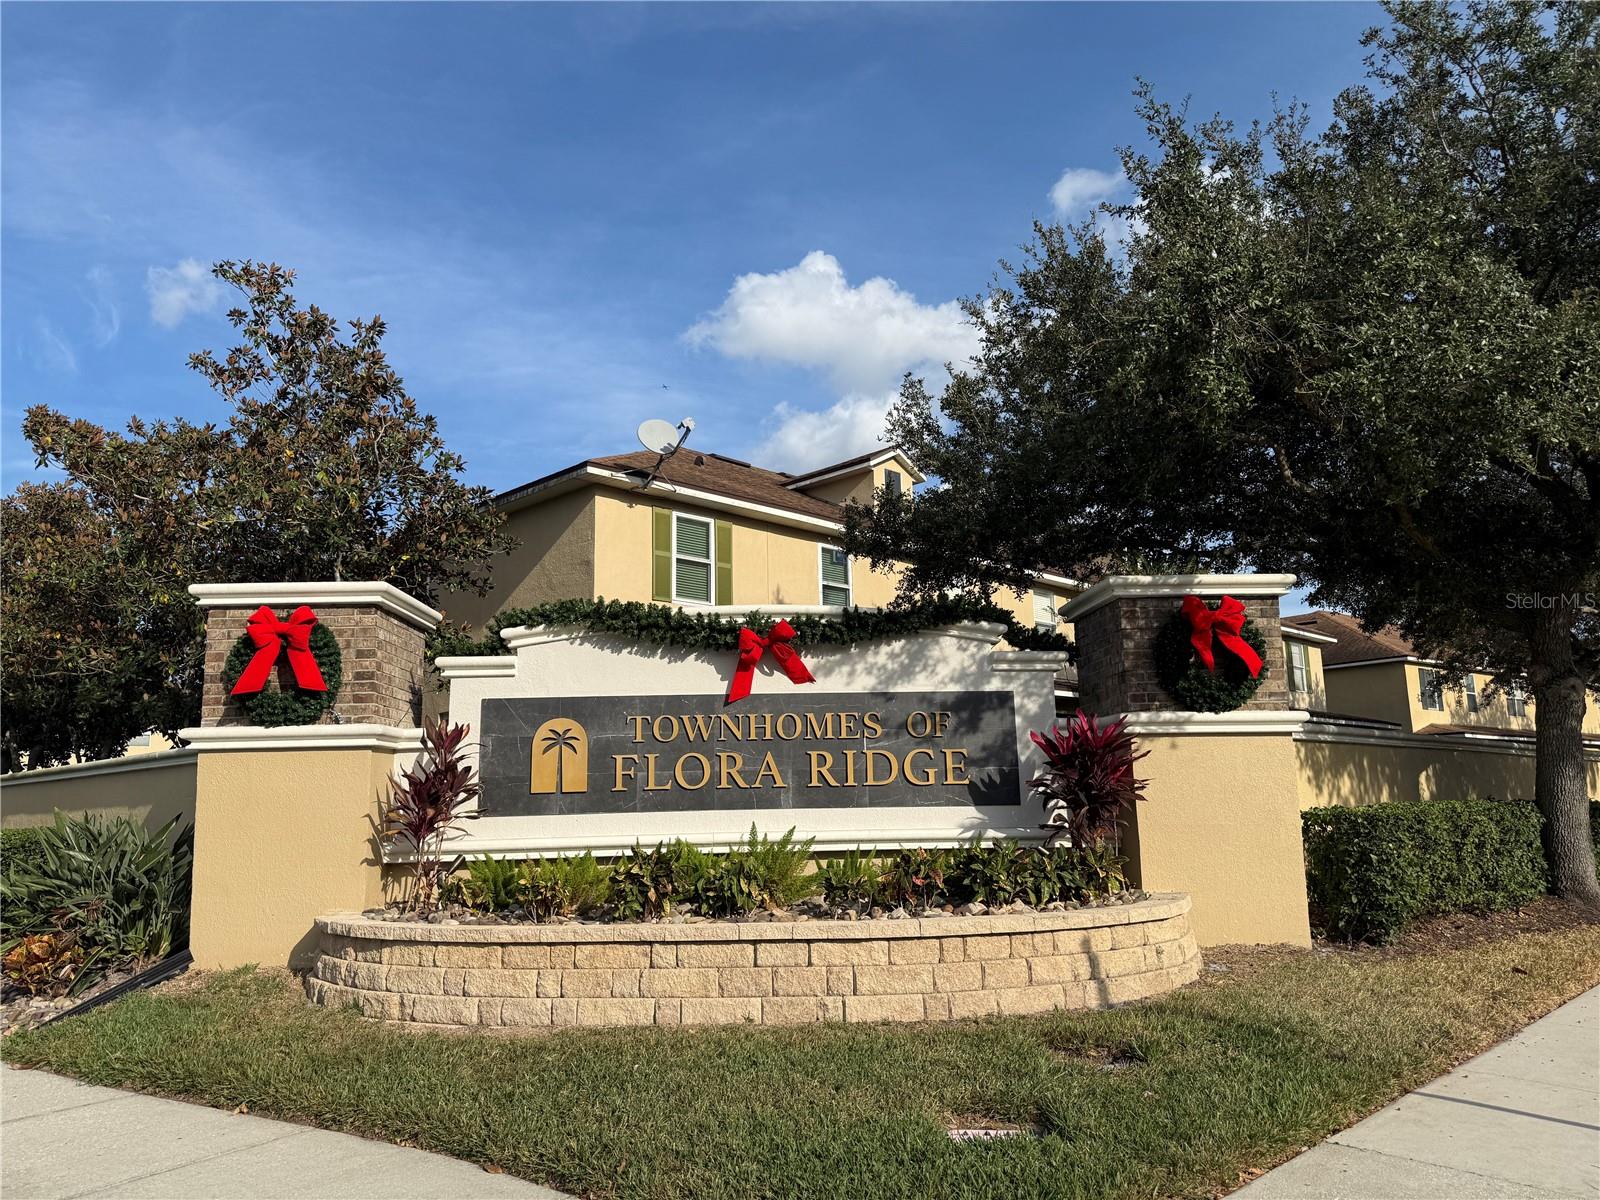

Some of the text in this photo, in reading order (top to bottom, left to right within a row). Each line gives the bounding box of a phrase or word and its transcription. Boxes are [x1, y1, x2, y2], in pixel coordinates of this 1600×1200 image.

[627, 710, 952, 744] TOWNHOMES OF
[611, 748, 971, 792] FLORA RIDGE
